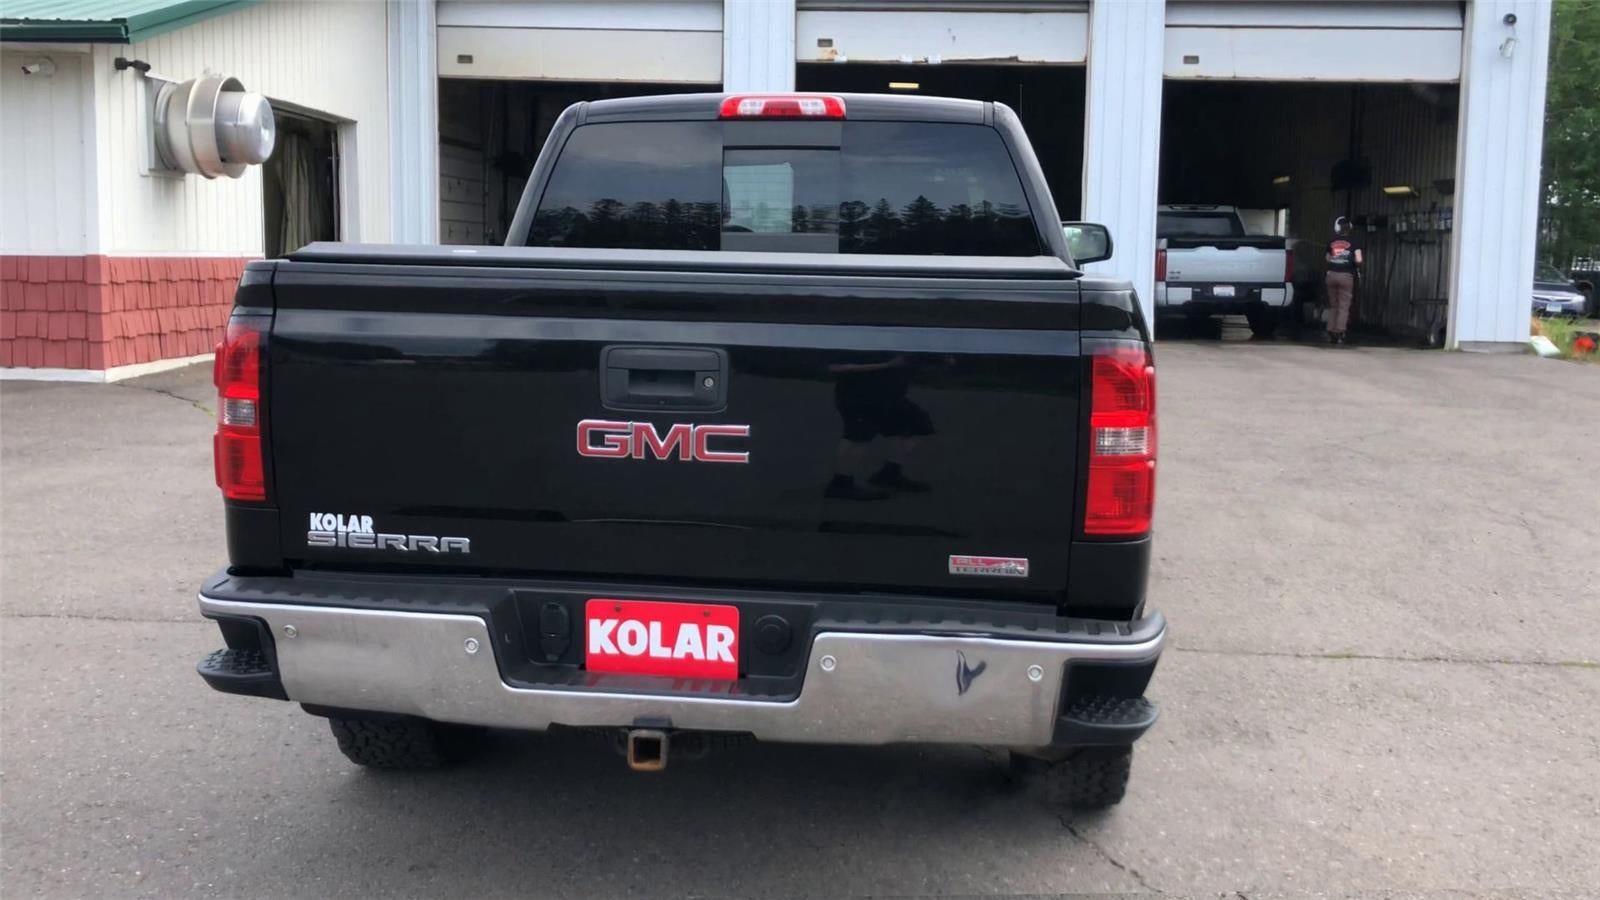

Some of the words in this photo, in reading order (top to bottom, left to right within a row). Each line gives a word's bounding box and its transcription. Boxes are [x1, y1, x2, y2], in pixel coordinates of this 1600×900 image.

[577, 419, 750, 463] GMC
[310, 512, 374, 533] KOLAR
[307, 530, 471, 553] SIERRA
[588, 618, 736, 663] KOLAR
